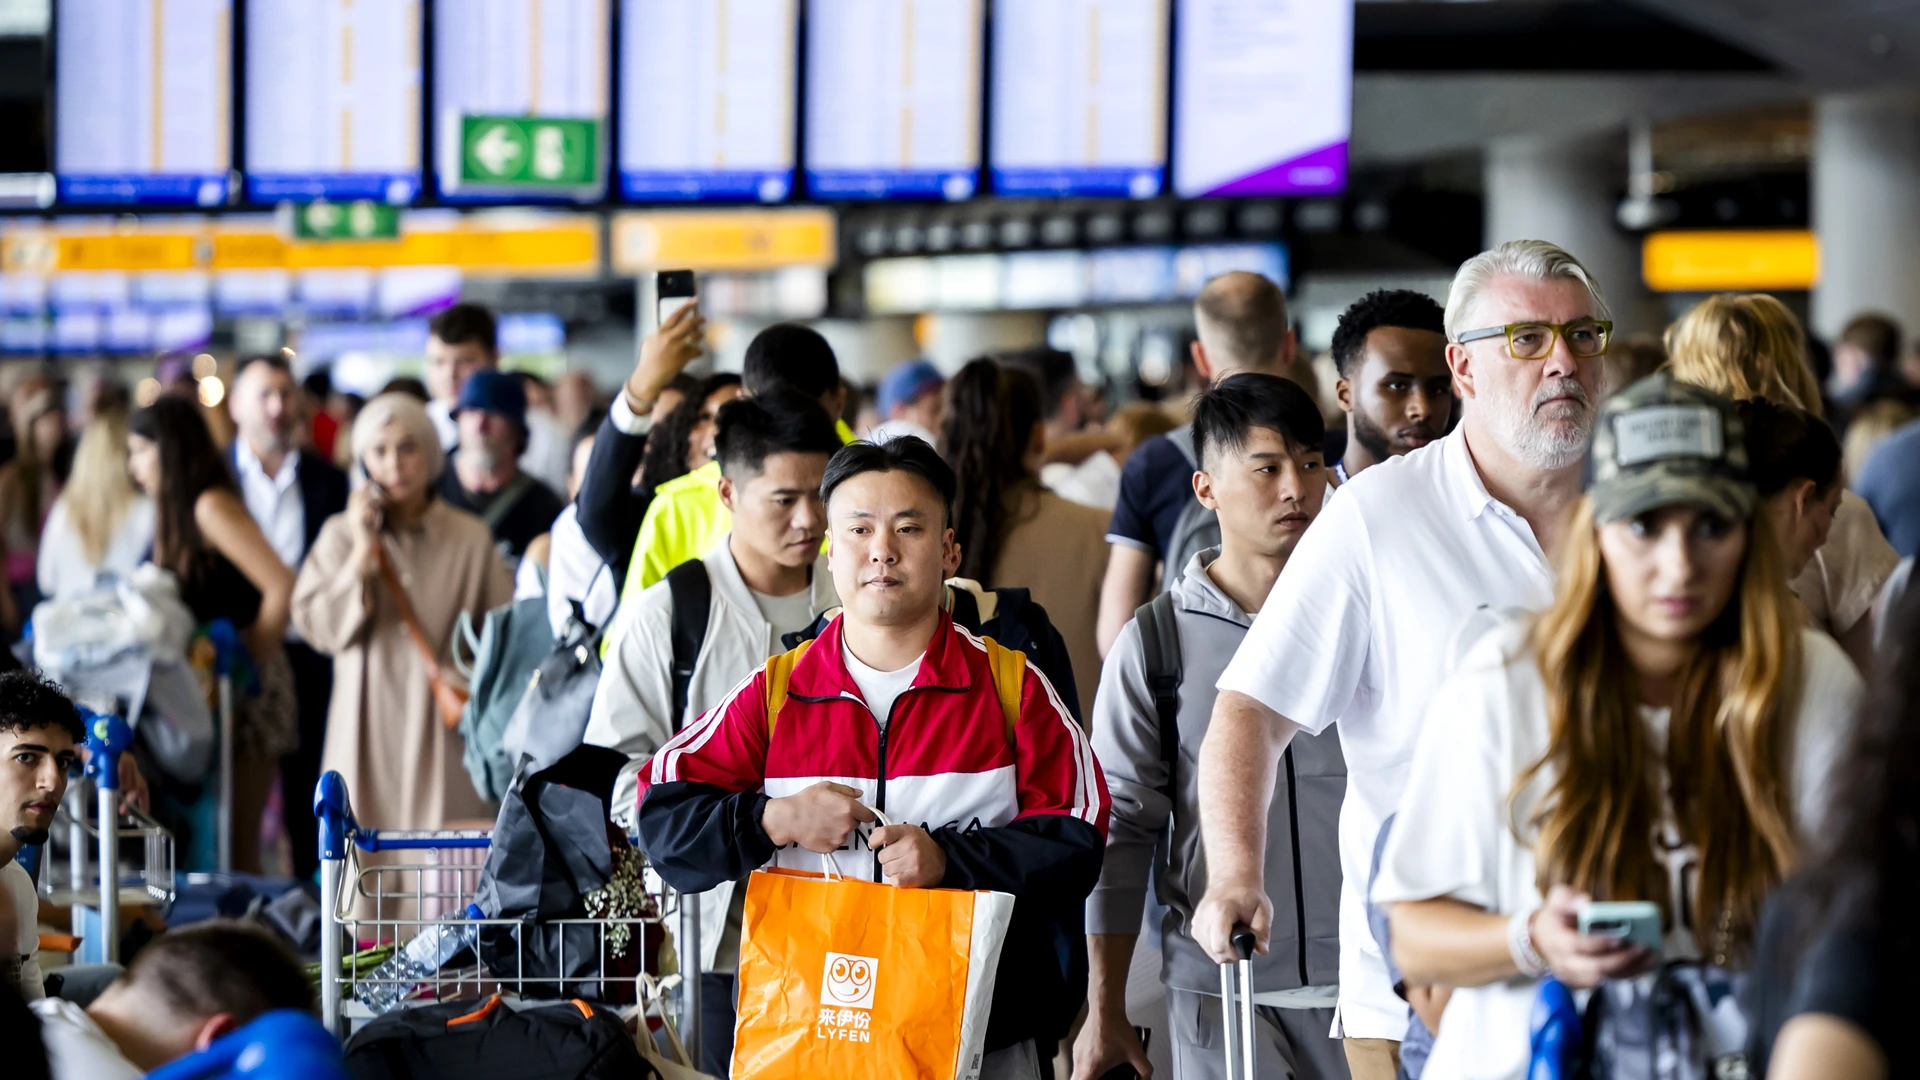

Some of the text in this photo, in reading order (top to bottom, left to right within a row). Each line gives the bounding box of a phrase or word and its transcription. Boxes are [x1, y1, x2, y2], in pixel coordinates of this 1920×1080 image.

[818, 1008, 871, 1029] 来伊份
[817, 1026, 870, 1043] LYFEN
